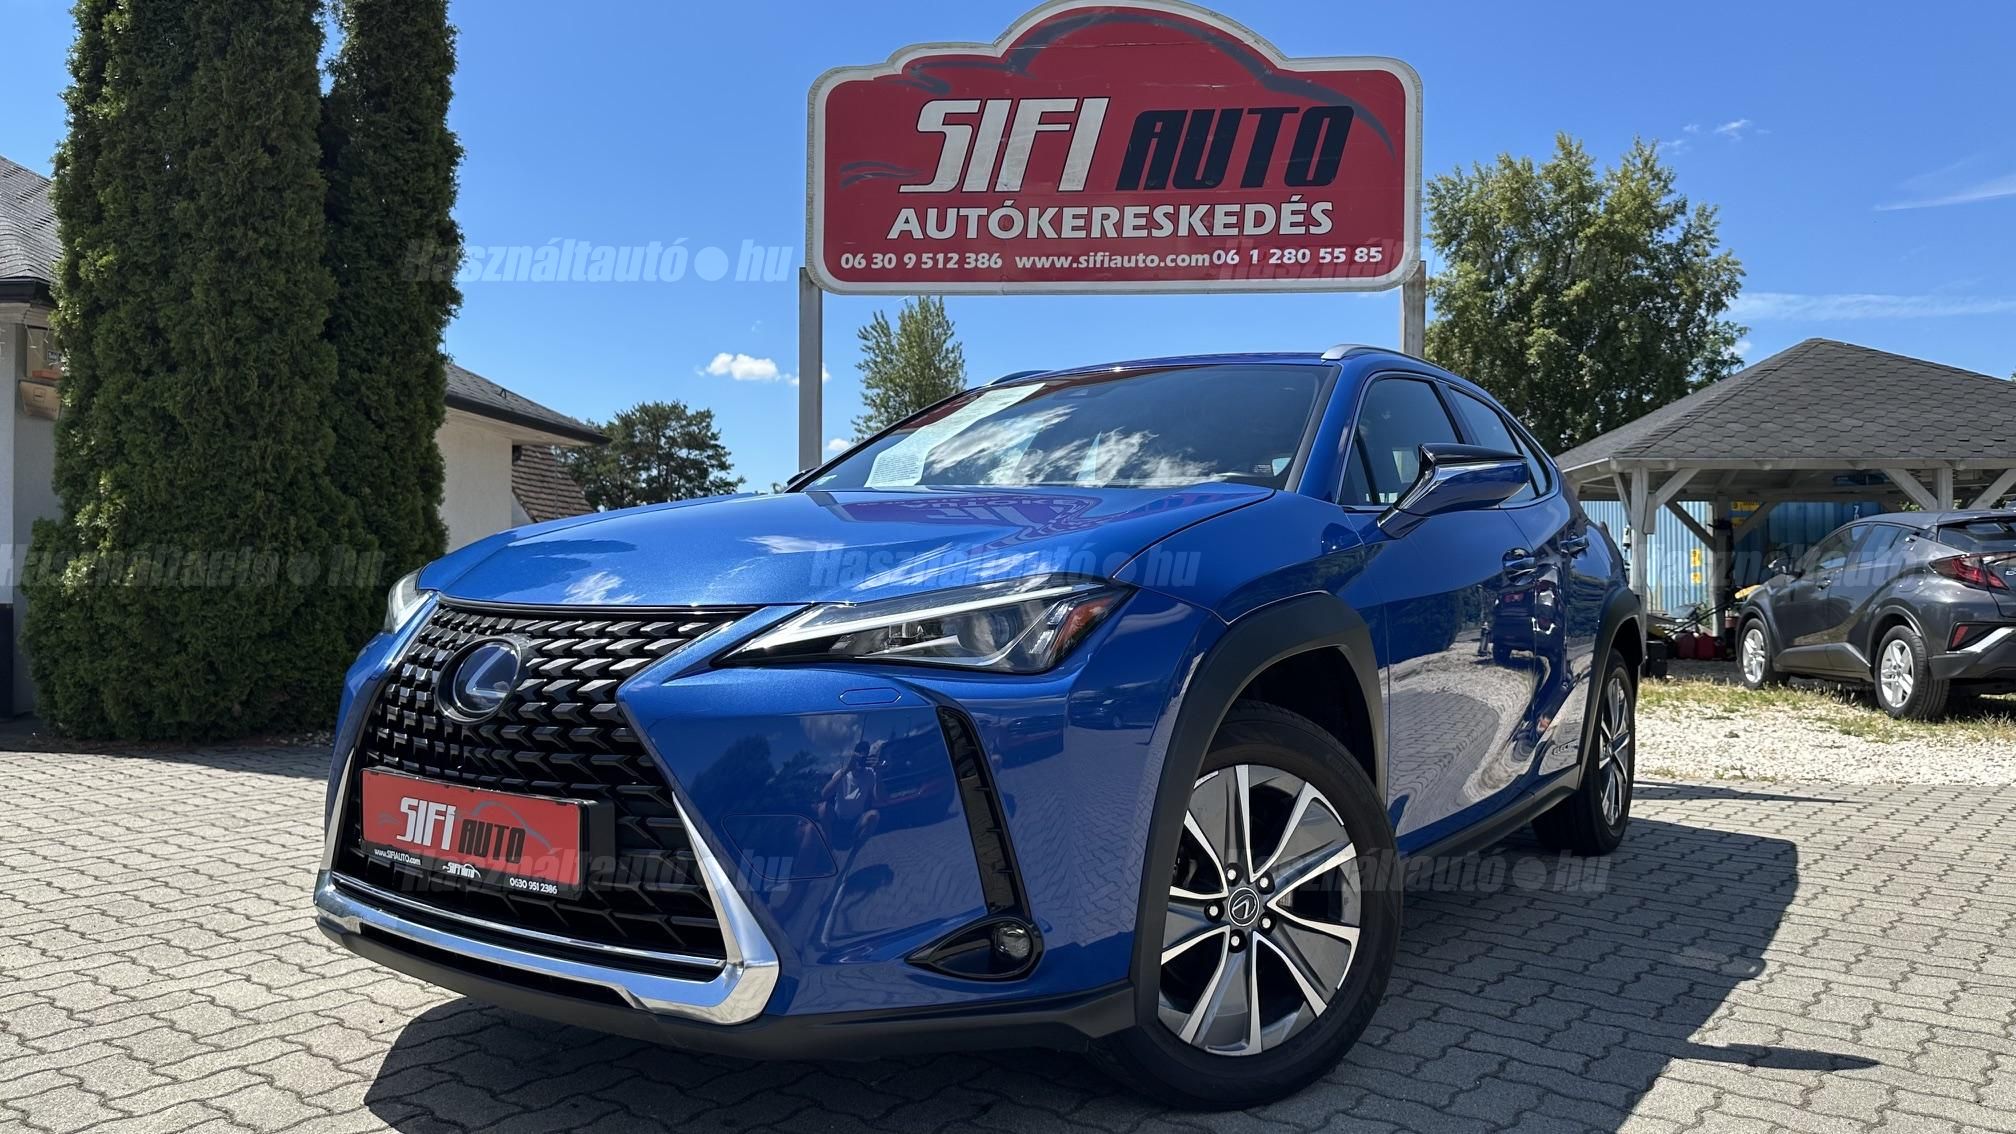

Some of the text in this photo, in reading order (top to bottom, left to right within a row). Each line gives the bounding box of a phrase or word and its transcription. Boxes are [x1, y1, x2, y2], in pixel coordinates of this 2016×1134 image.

[899, 97, 1355, 193] SIFI AUTO
[886, 194, 1334, 239] AUTÓKERESKEDÉS
[840, 246, 1383, 269] 06 30 9 512 386 www.sifiauto.com 06 1 280 55 85
[458, 818, 526, 864] AUTO
[509, 877, 528, 889] 0630
[540, 883, 558, 895] 2386
